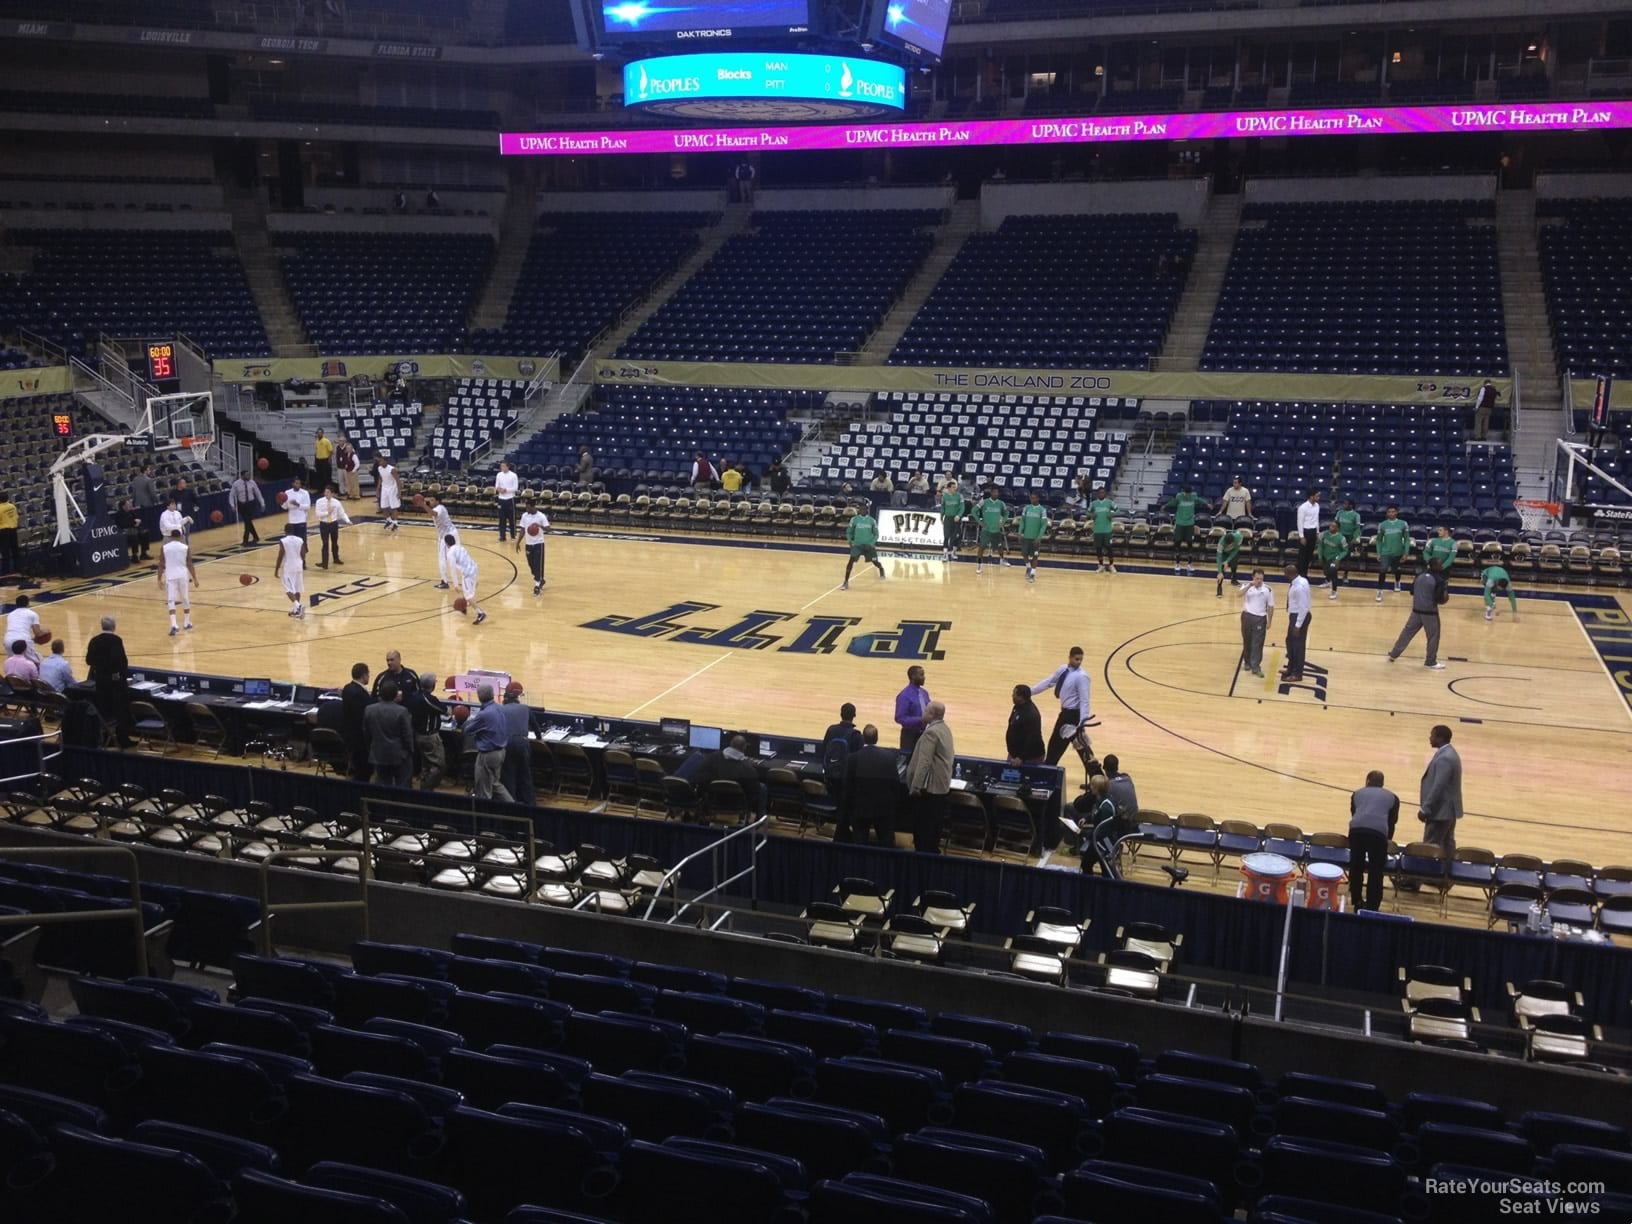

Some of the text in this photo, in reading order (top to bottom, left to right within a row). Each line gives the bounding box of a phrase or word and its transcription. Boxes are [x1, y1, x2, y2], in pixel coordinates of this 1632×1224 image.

[18, 23, 48, 34] MIAMI
[677, 29, 732, 39] DAKTRONICS
[141, 31, 191, 43] LOUISVILLE
[261, 38, 319, 50] GEORGIA TECH
[378, 44, 437, 57] FLORIDA STATE
[765, 61, 787, 71] MAN
[717, 68, 752, 80] Blocks
[765, 79, 785, 89] PITT
[1236, 116, 1287, 132] UPMC
[1451, 110, 1506, 126] UPMC
[846, 129, 889, 144] UPMC
[1031, 123, 1078, 138] UPMC
[520, 137, 558, 150] UPMC
[674, 133, 713, 148] UPMC
[150, 346, 171, 358] 60:00
[154, 357, 170, 376] 35
[934, 373, 1111, 390] THE OAKLAND ZOO
[58, 423, 69, 433] 35
[892, 512, 937, 536] PITT
[91, 524, 118, 538] UPMC
[880, 535, 944, 545] BASKETBALL
[102, 547, 120, 560] PNC
[309, 576, 391, 608] ACC
[577, 600, 952, 661] PITT
[1259, 883, 1271, 895] G
[1317, 887, 1329, 899] G
